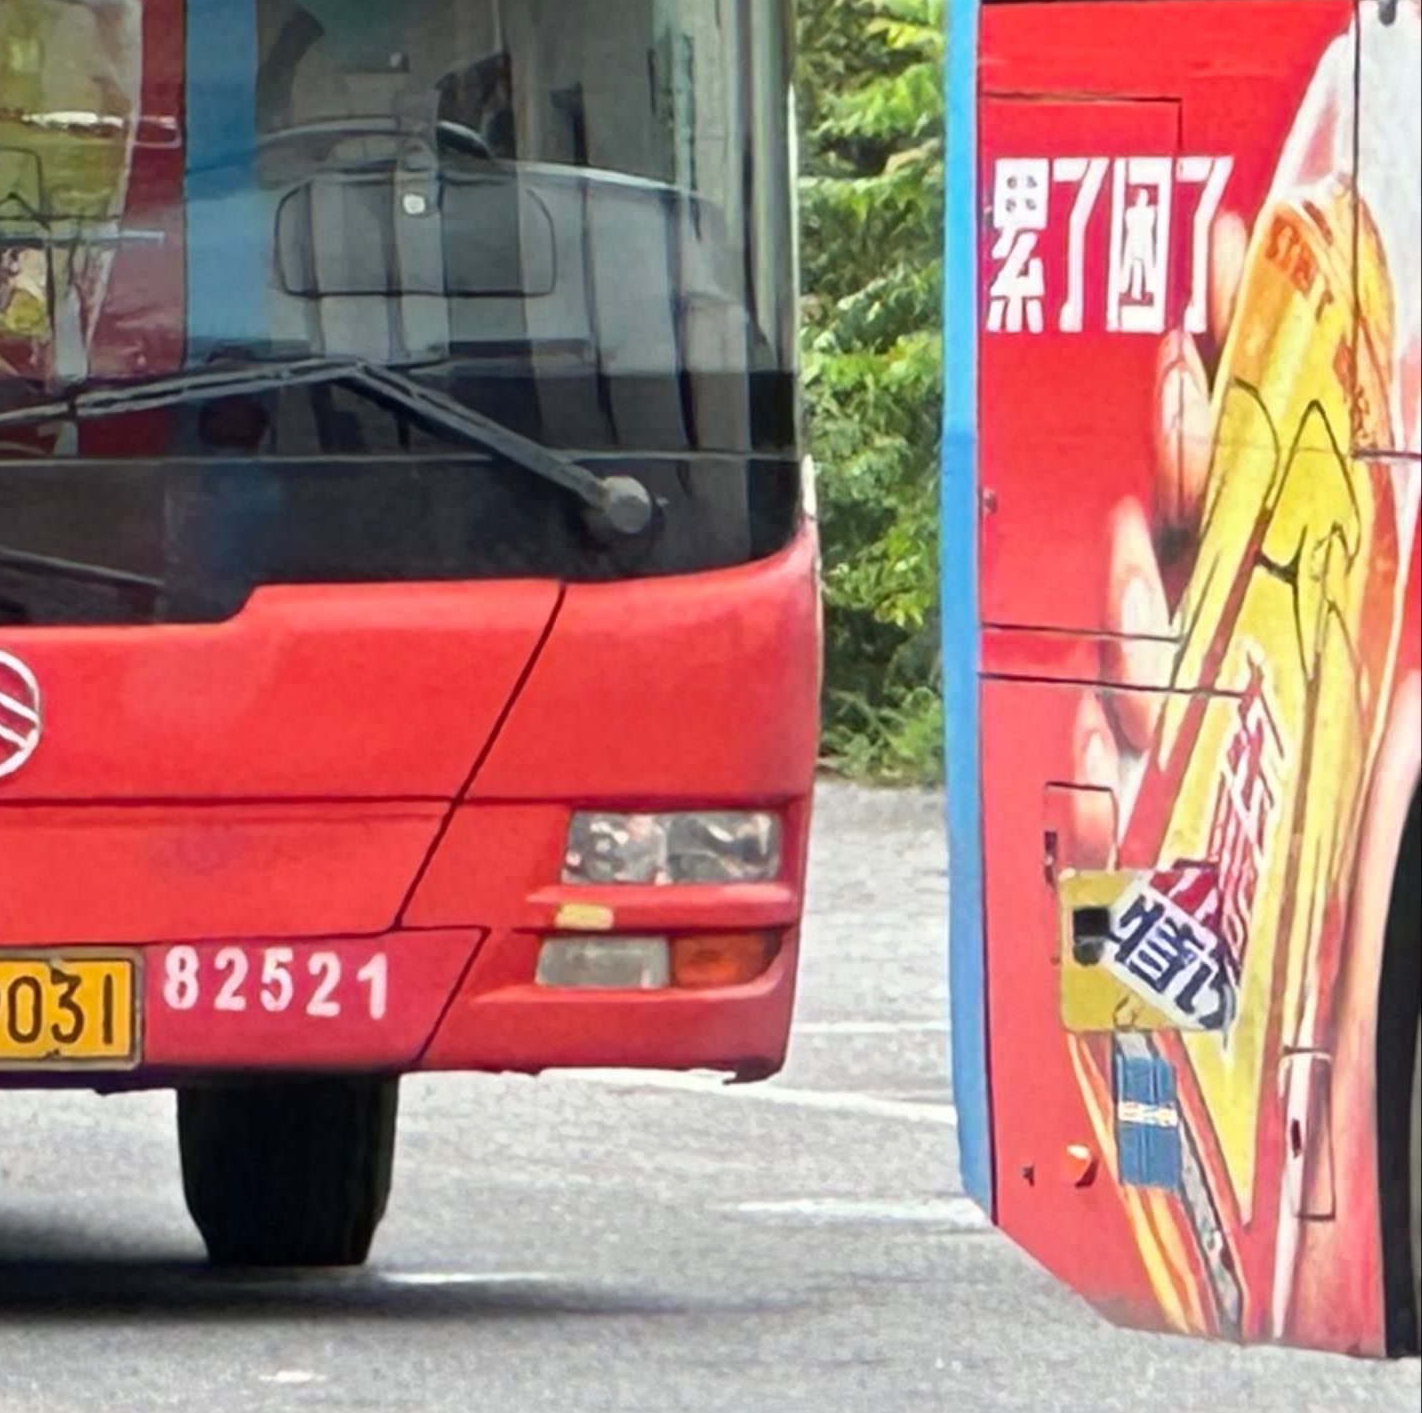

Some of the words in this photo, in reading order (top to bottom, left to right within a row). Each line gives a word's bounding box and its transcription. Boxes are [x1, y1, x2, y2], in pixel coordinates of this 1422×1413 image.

[986, 155, 1235, 335] 累了困了
[163, 945, 390, 1020] 82521
